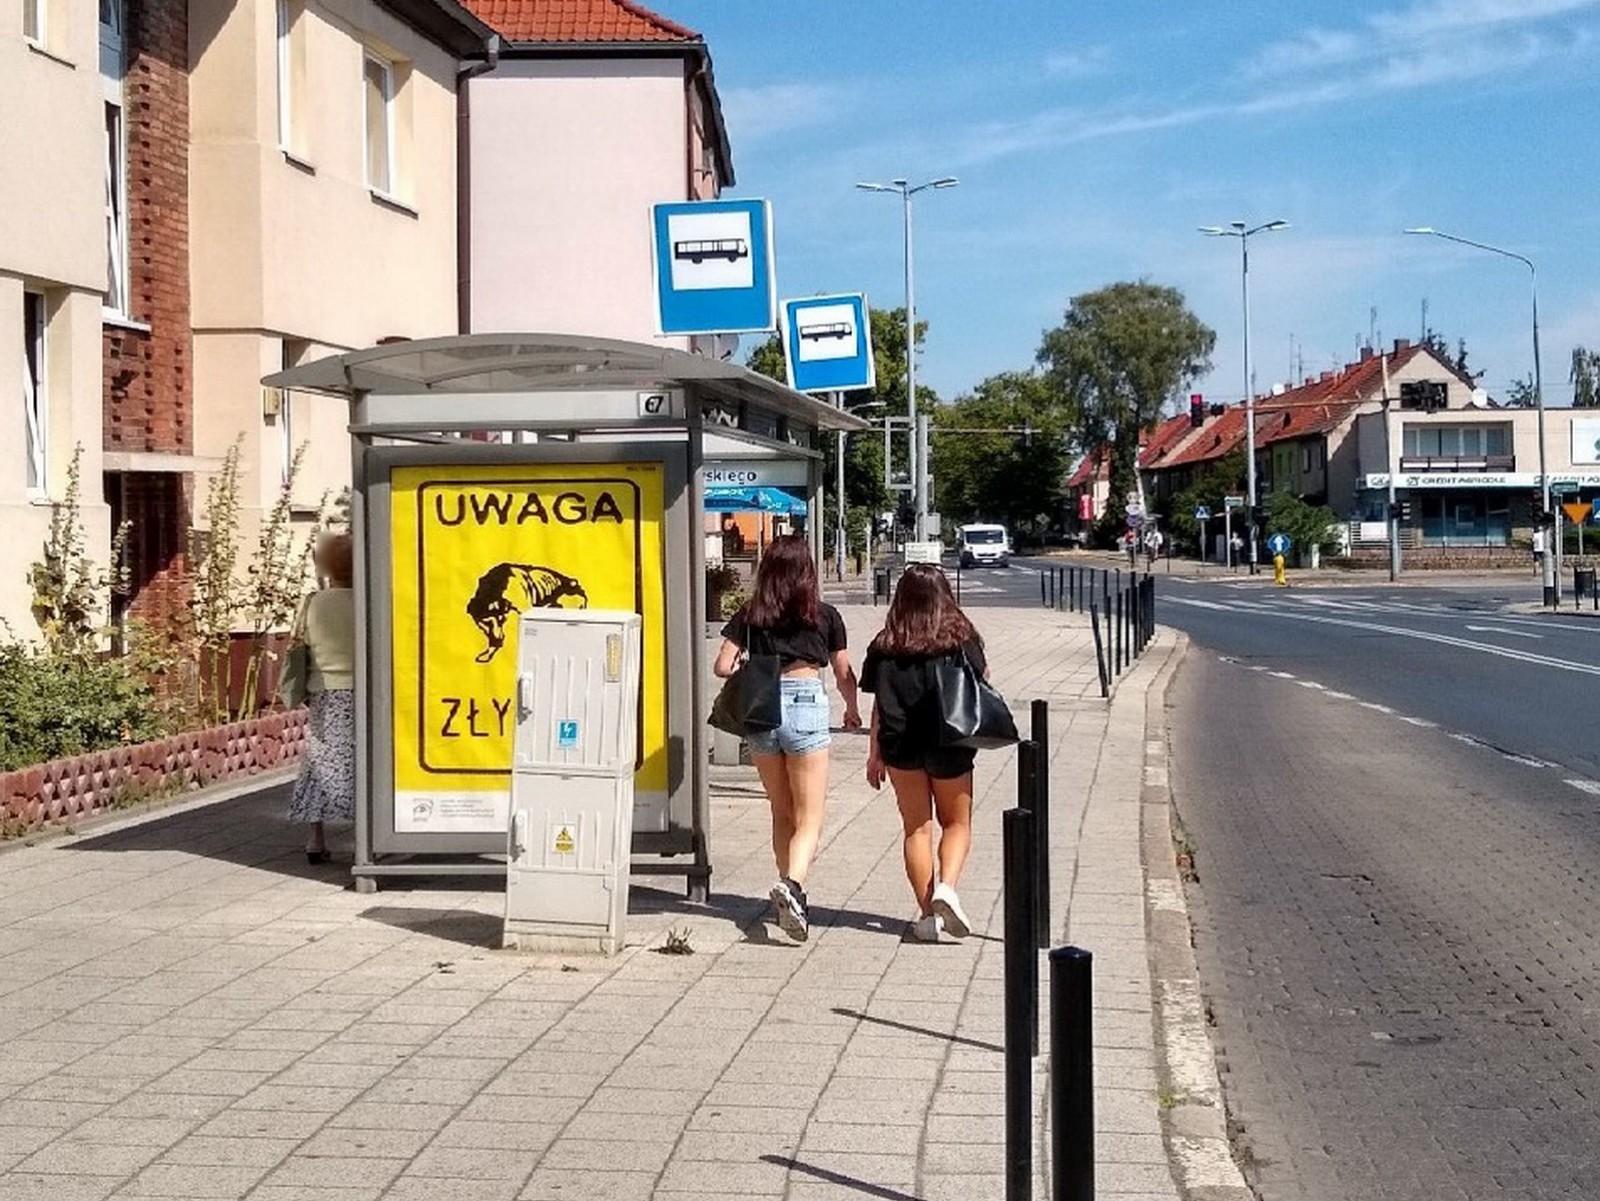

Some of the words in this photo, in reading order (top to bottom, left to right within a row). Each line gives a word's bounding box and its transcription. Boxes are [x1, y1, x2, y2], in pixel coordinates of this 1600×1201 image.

[644, 395, 664, 414] 67
[435, 491, 625, 527] UWAGA
[441, 697, 511, 737] ZŁY
